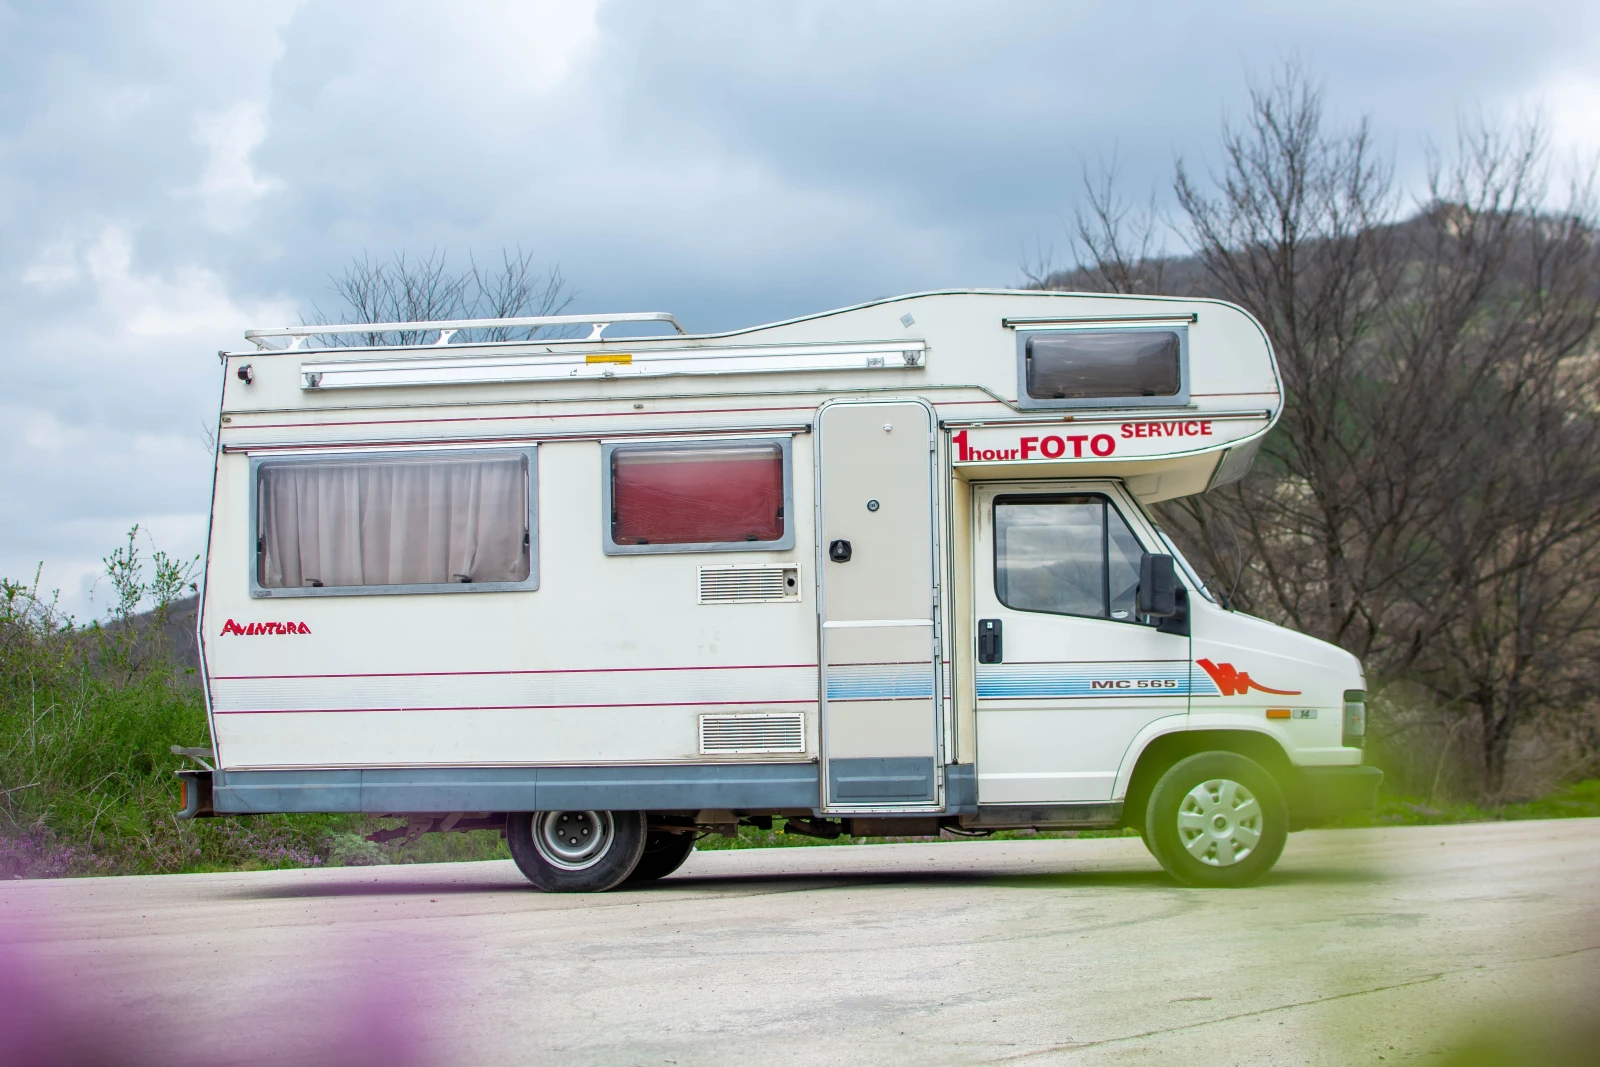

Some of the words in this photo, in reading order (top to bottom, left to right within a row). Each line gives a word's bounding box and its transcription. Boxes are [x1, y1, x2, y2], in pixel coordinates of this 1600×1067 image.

[1020, 434, 1117, 460] FOTO
[1120, 421, 1212, 438] SERVICE
[1092, 680, 1131, 689] MC
[1137, 679, 1176, 688] 565
